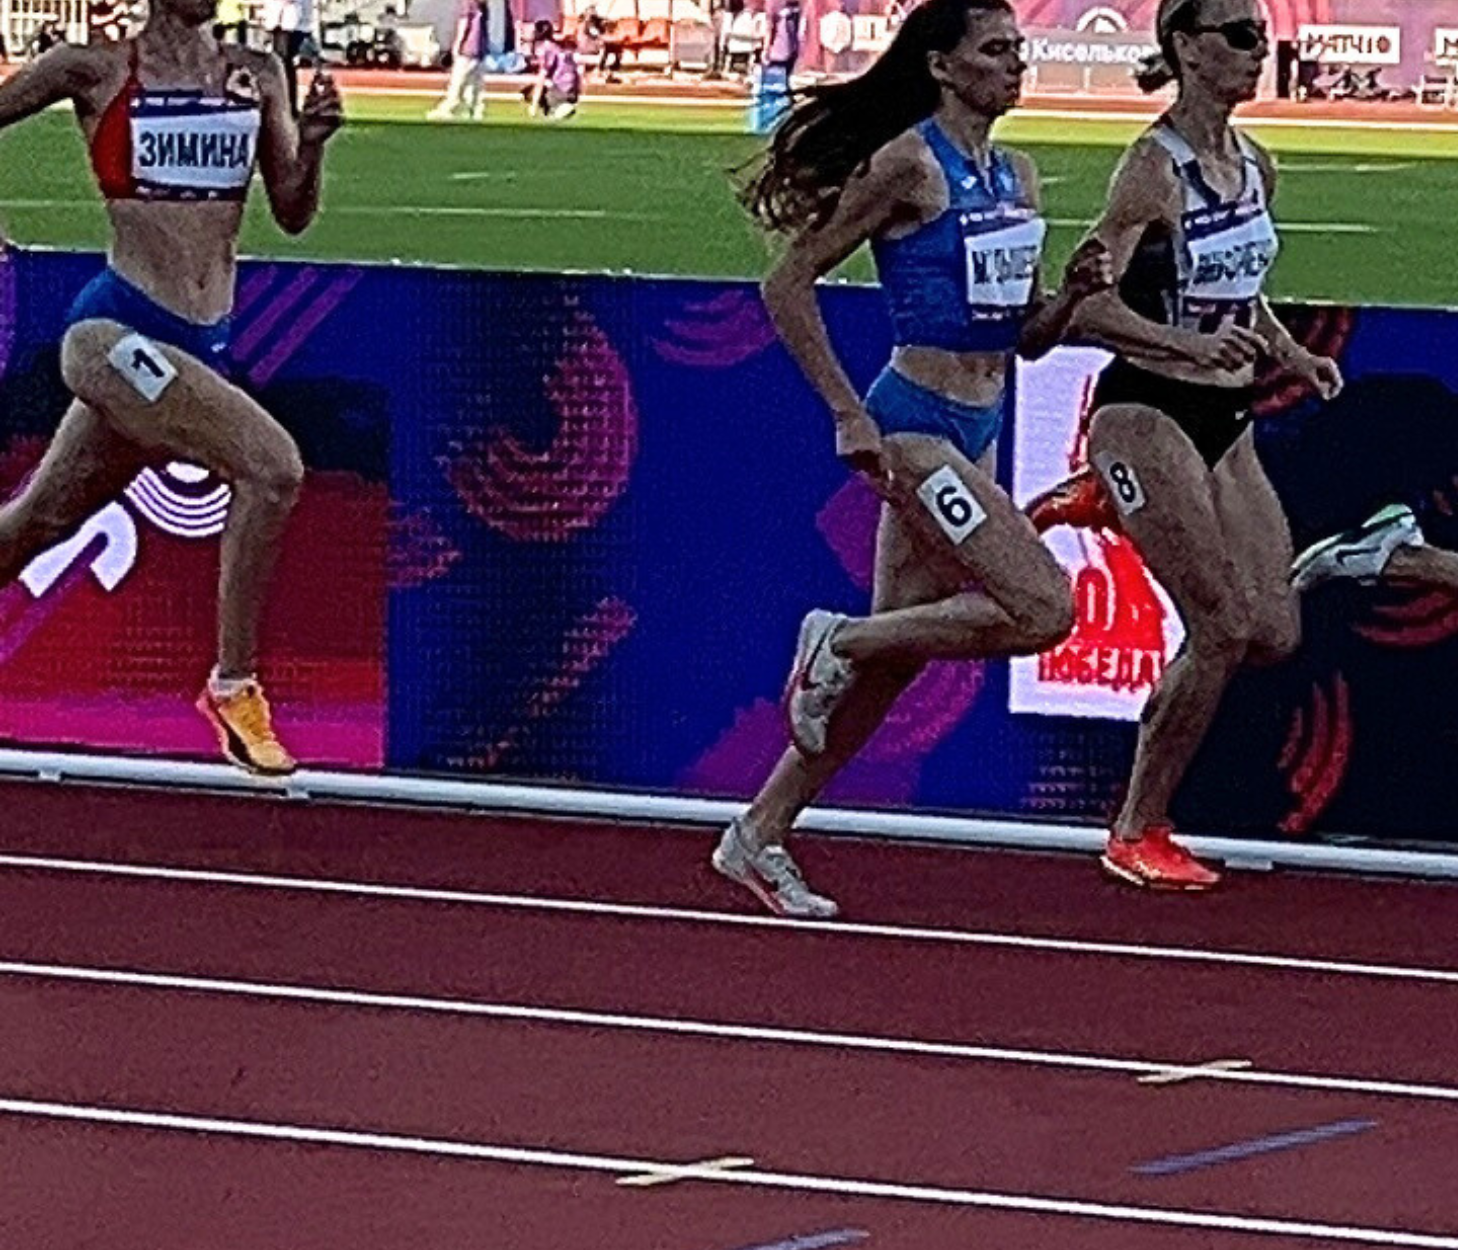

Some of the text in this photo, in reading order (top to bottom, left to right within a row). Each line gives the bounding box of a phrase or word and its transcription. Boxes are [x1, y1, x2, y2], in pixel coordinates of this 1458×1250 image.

[138, 131, 249, 168] ЗИМИНА
[129, 347, 164, 379] 1
[1110, 461, 1136, 504] 8
[935, 485, 973, 526] 6
